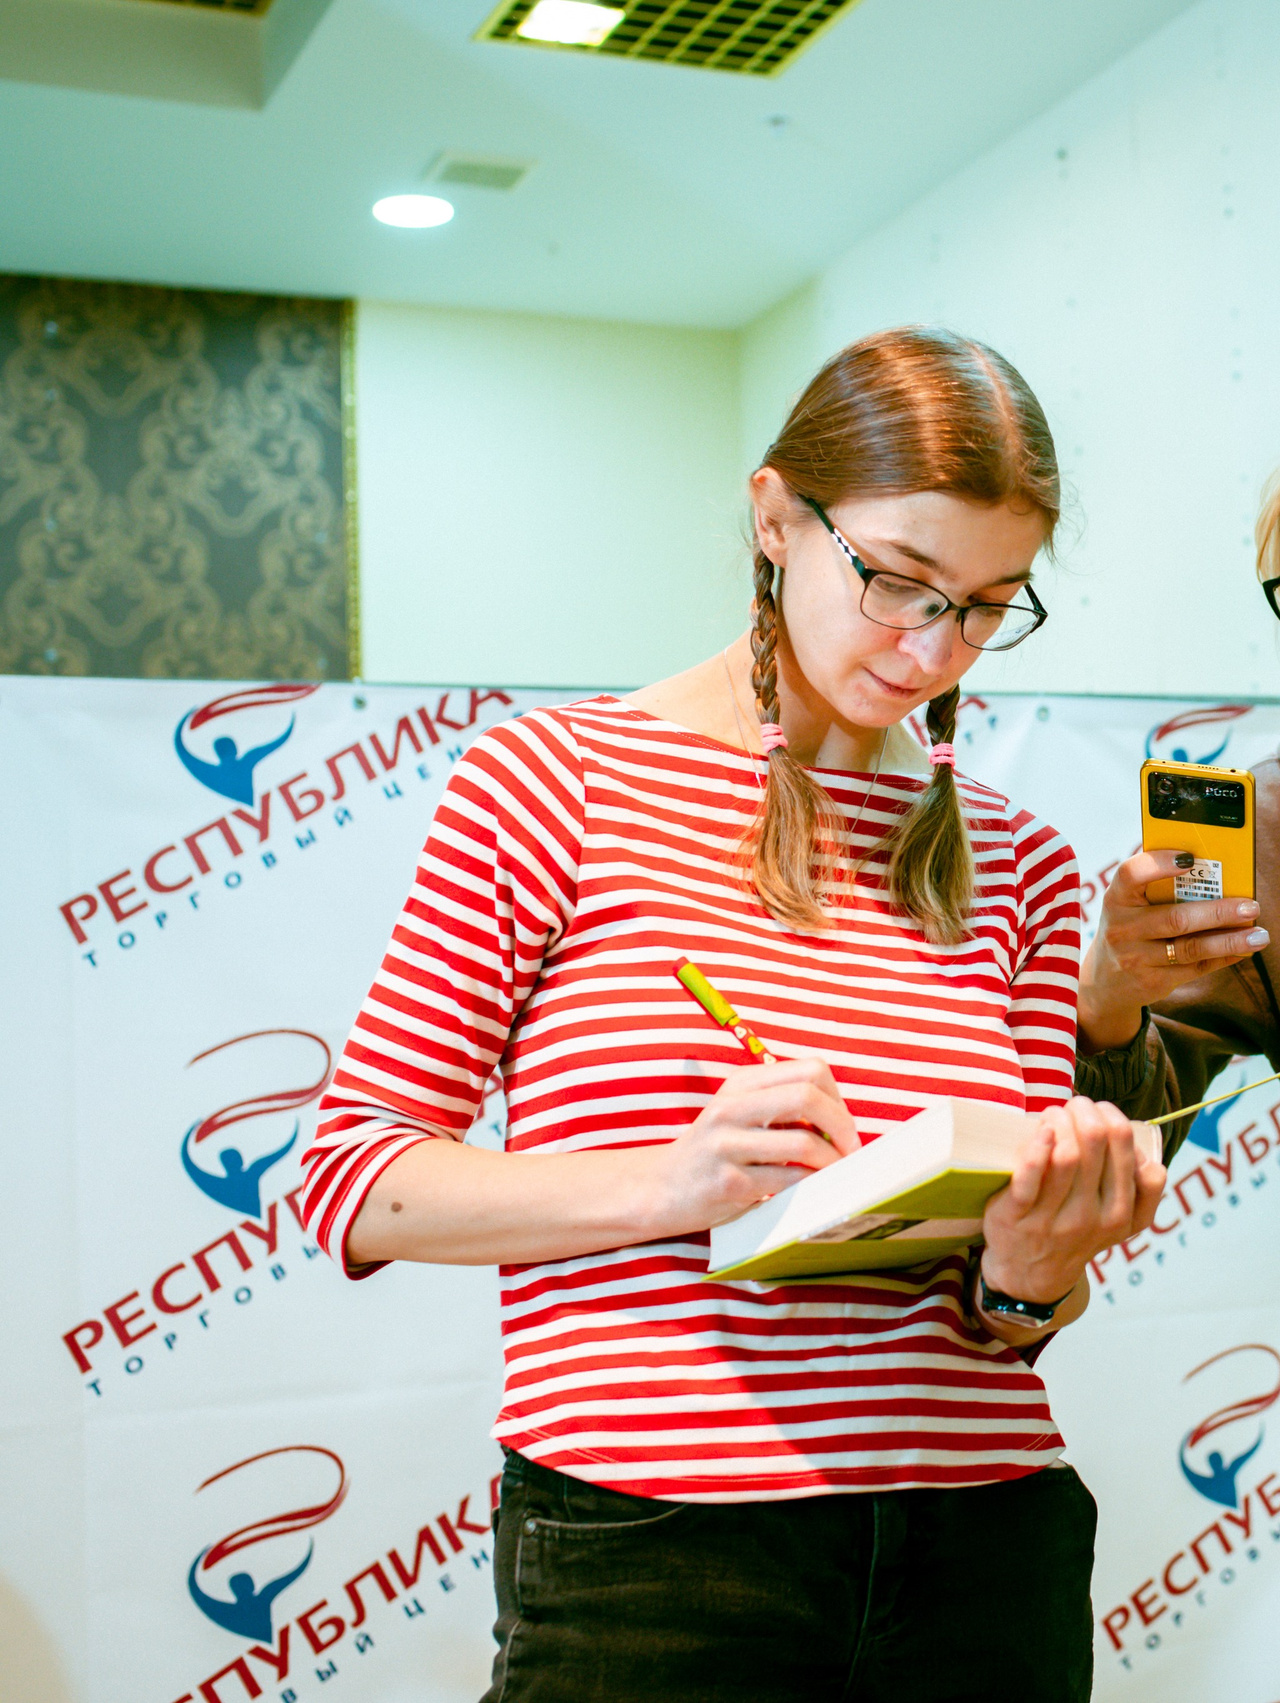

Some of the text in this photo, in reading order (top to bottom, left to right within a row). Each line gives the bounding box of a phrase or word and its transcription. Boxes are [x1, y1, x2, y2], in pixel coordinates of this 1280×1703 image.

[58, 687, 515, 945] РЕСПУБЛИКА
[82, 806, 353, 968] ТОРГОВЫЙ
[170, 1472, 502, 1703] ПУБЛИК
[404, 1549, 490, 1618] ЦЕН
